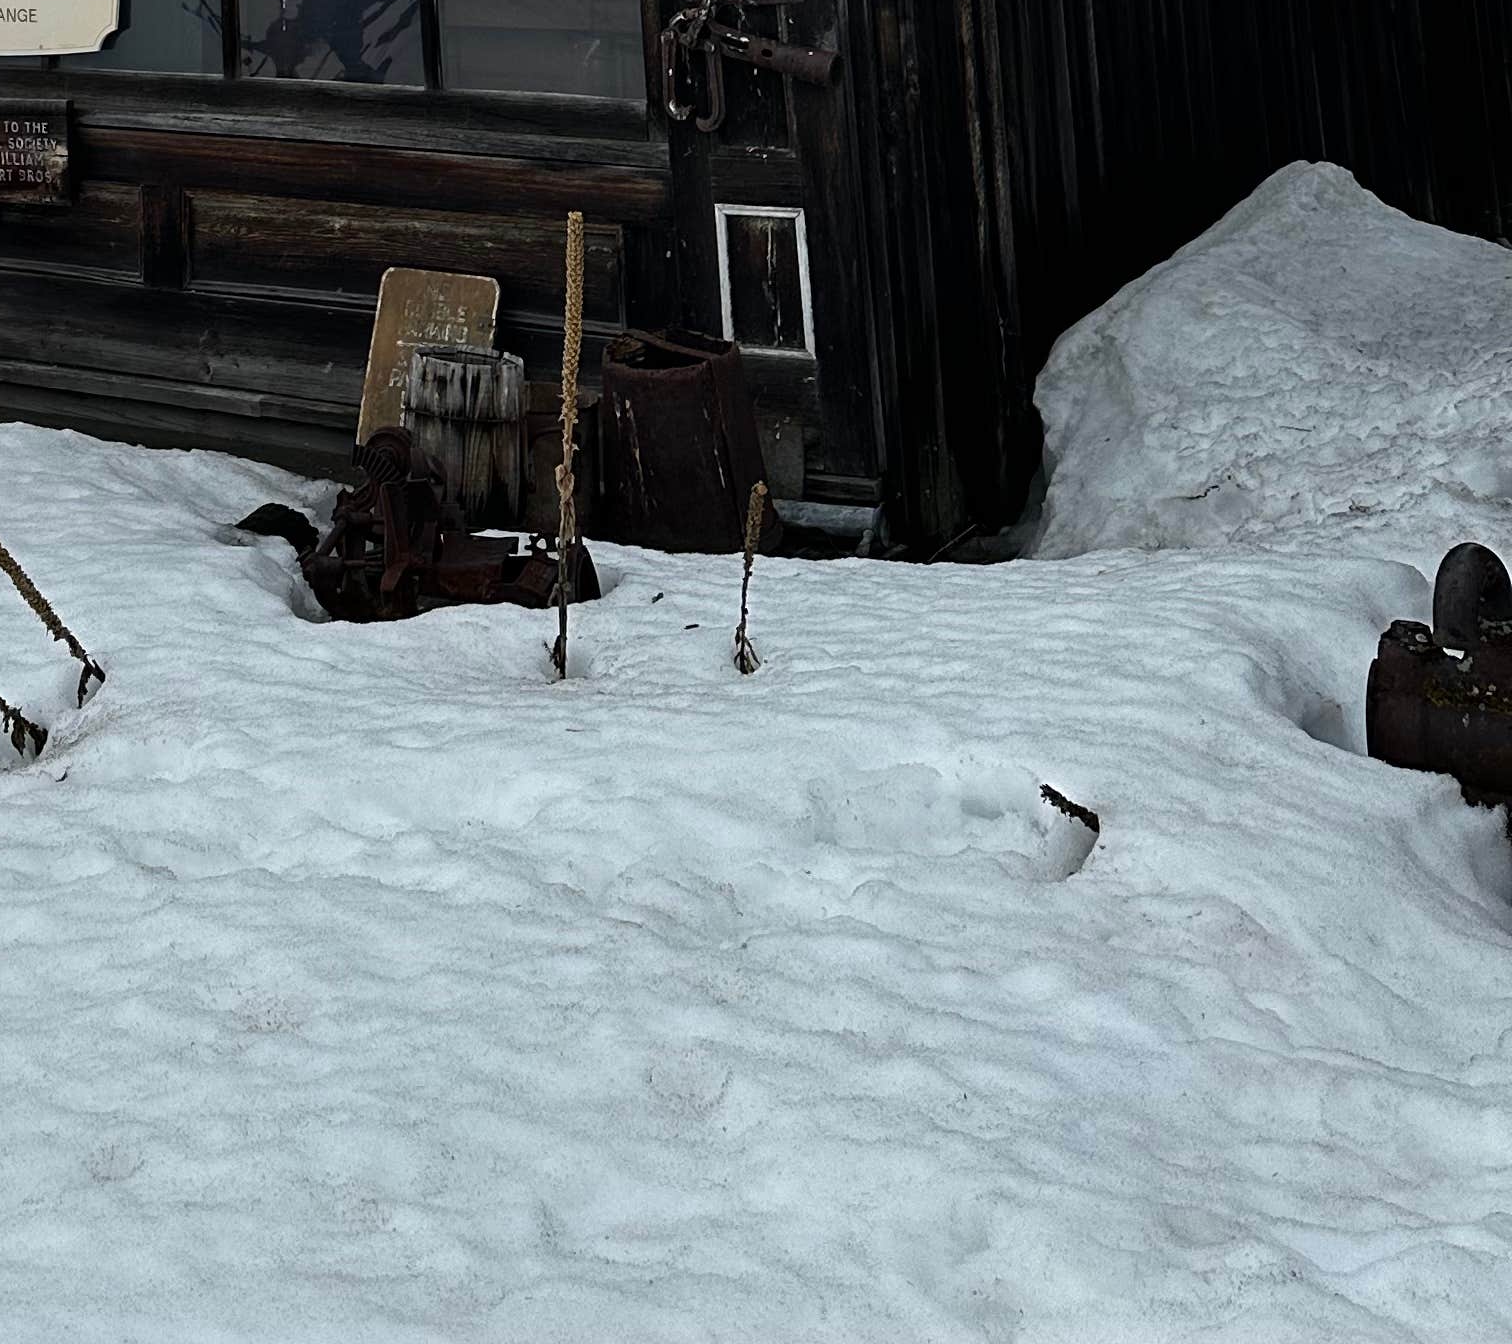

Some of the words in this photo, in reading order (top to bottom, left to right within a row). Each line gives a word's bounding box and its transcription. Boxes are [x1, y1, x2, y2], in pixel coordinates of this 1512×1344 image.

[4, 121, 19, 133] TO
[25, 122, 49, 135] THE
[8, 137, 57, 152] SOCIETY
